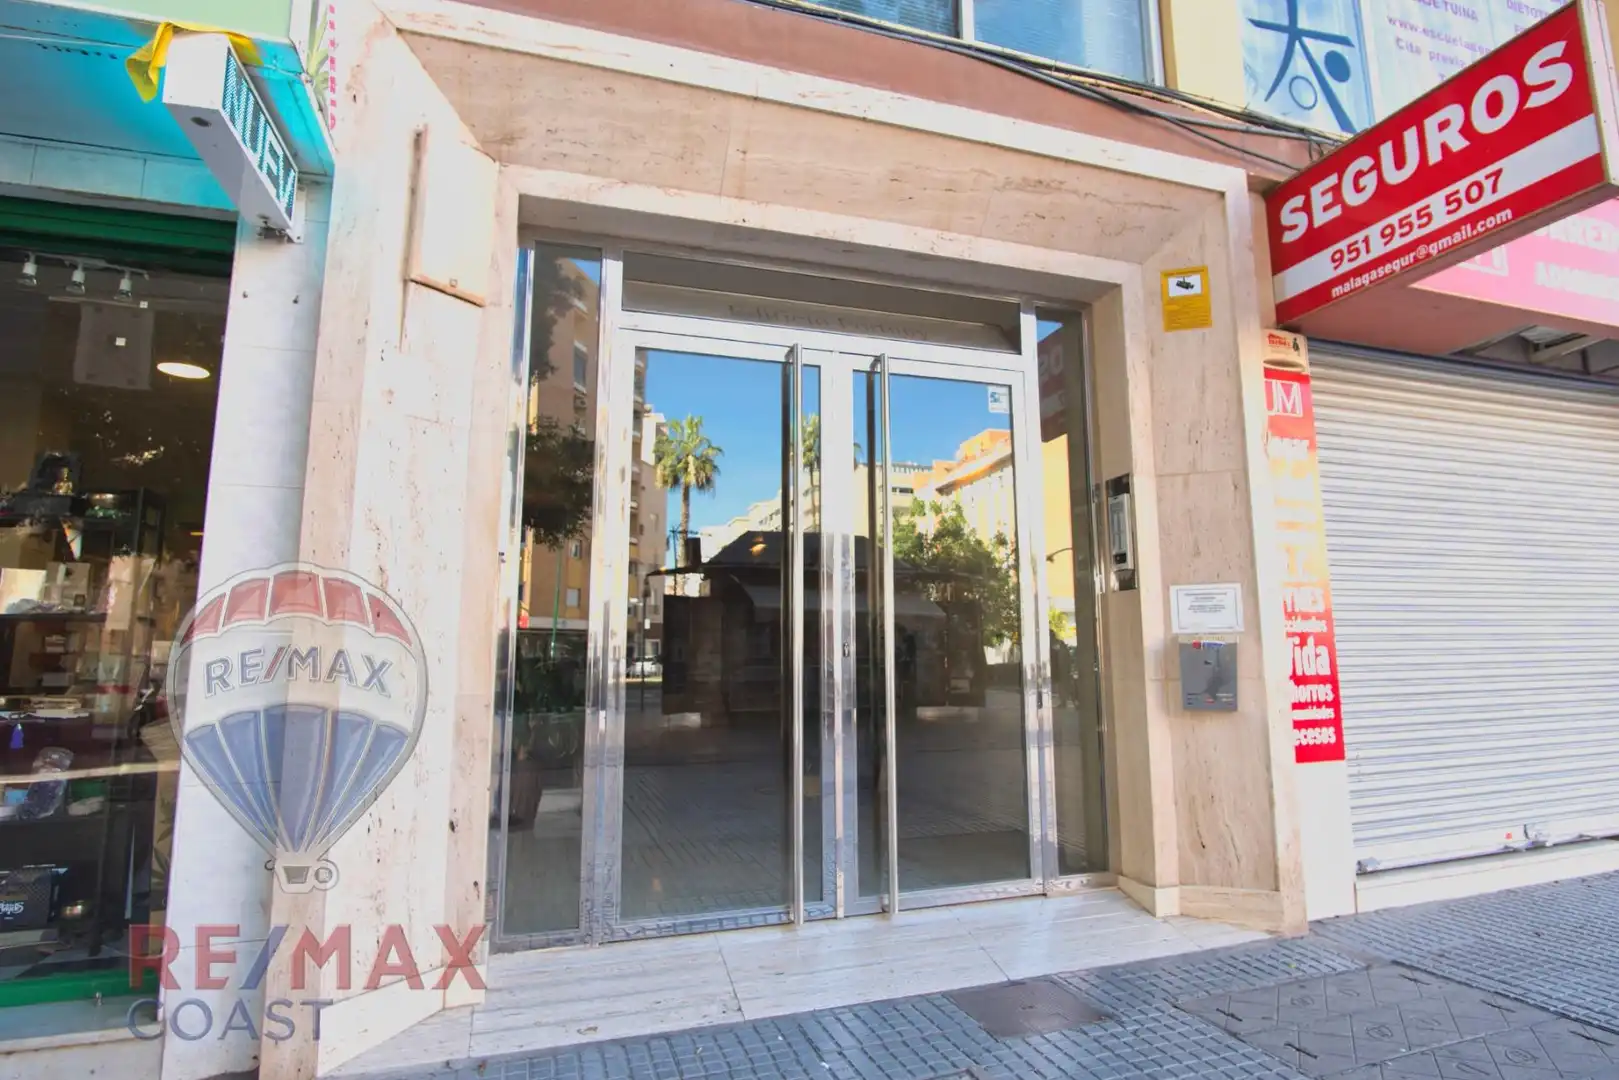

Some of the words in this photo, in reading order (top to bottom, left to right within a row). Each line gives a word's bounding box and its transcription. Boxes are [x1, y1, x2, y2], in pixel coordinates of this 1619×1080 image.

[1280, 40, 1573, 243] SEGUROS
[1330, 236, 1372, 271] 951
[1380, 204, 1434, 247] 955
[1445, 168, 1504, 216] 507
[1331, 208, 1513, 299] malagasegur@gmail.com
